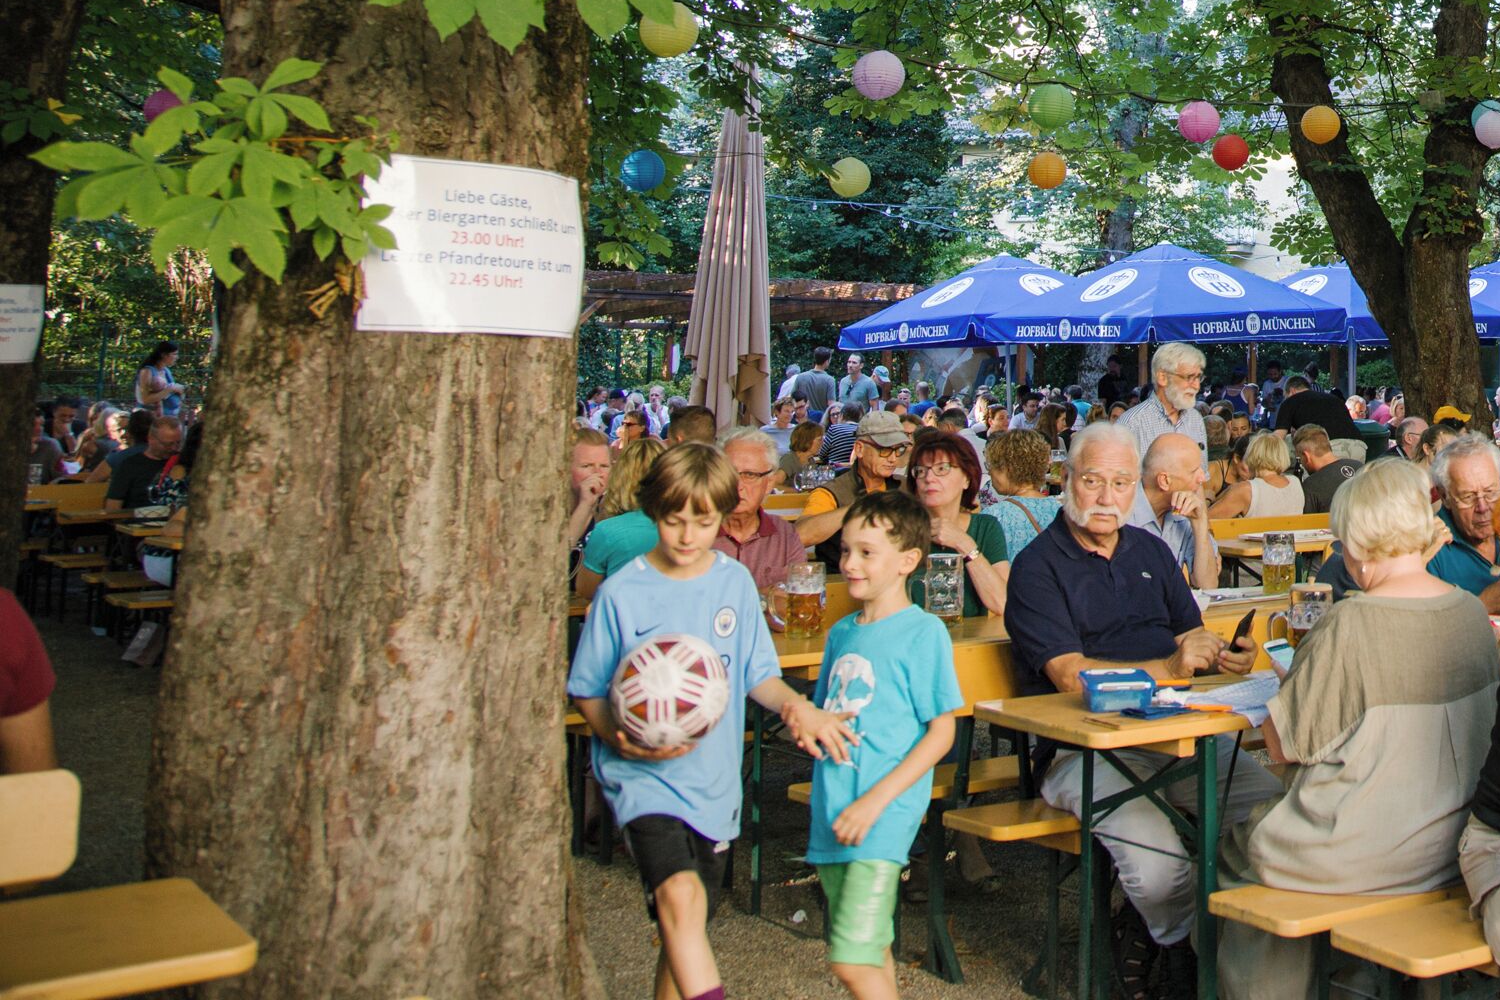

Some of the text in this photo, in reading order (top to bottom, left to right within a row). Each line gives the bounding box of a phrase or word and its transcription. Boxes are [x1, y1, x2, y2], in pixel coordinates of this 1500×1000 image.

[445, 189, 532, 211] Liebe Gäste,
[427, 209, 505, 227] Biergarten
[510, 215, 558, 233] schließt
[561, 225, 577, 234] um
[451, 231, 525, 248] 23.00 Uhr!
[439, 251, 534, 270] Pfandretoure
[538, 258, 552, 272] ist
[556, 263, 572, 274] um
[449, 272, 524, 288] 22.45 Uhr!
[865, 324, 950, 344] HOFBRÄU MÜNCHEN
[1016, 323, 1058, 338] HOFBRÄU
[1072, 323, 1121, 338] MÜNCHEN
[1193, 318, 1244, 335] HOFBRÄU
[1262, 316, 1316, 331] MÜNCHEN
